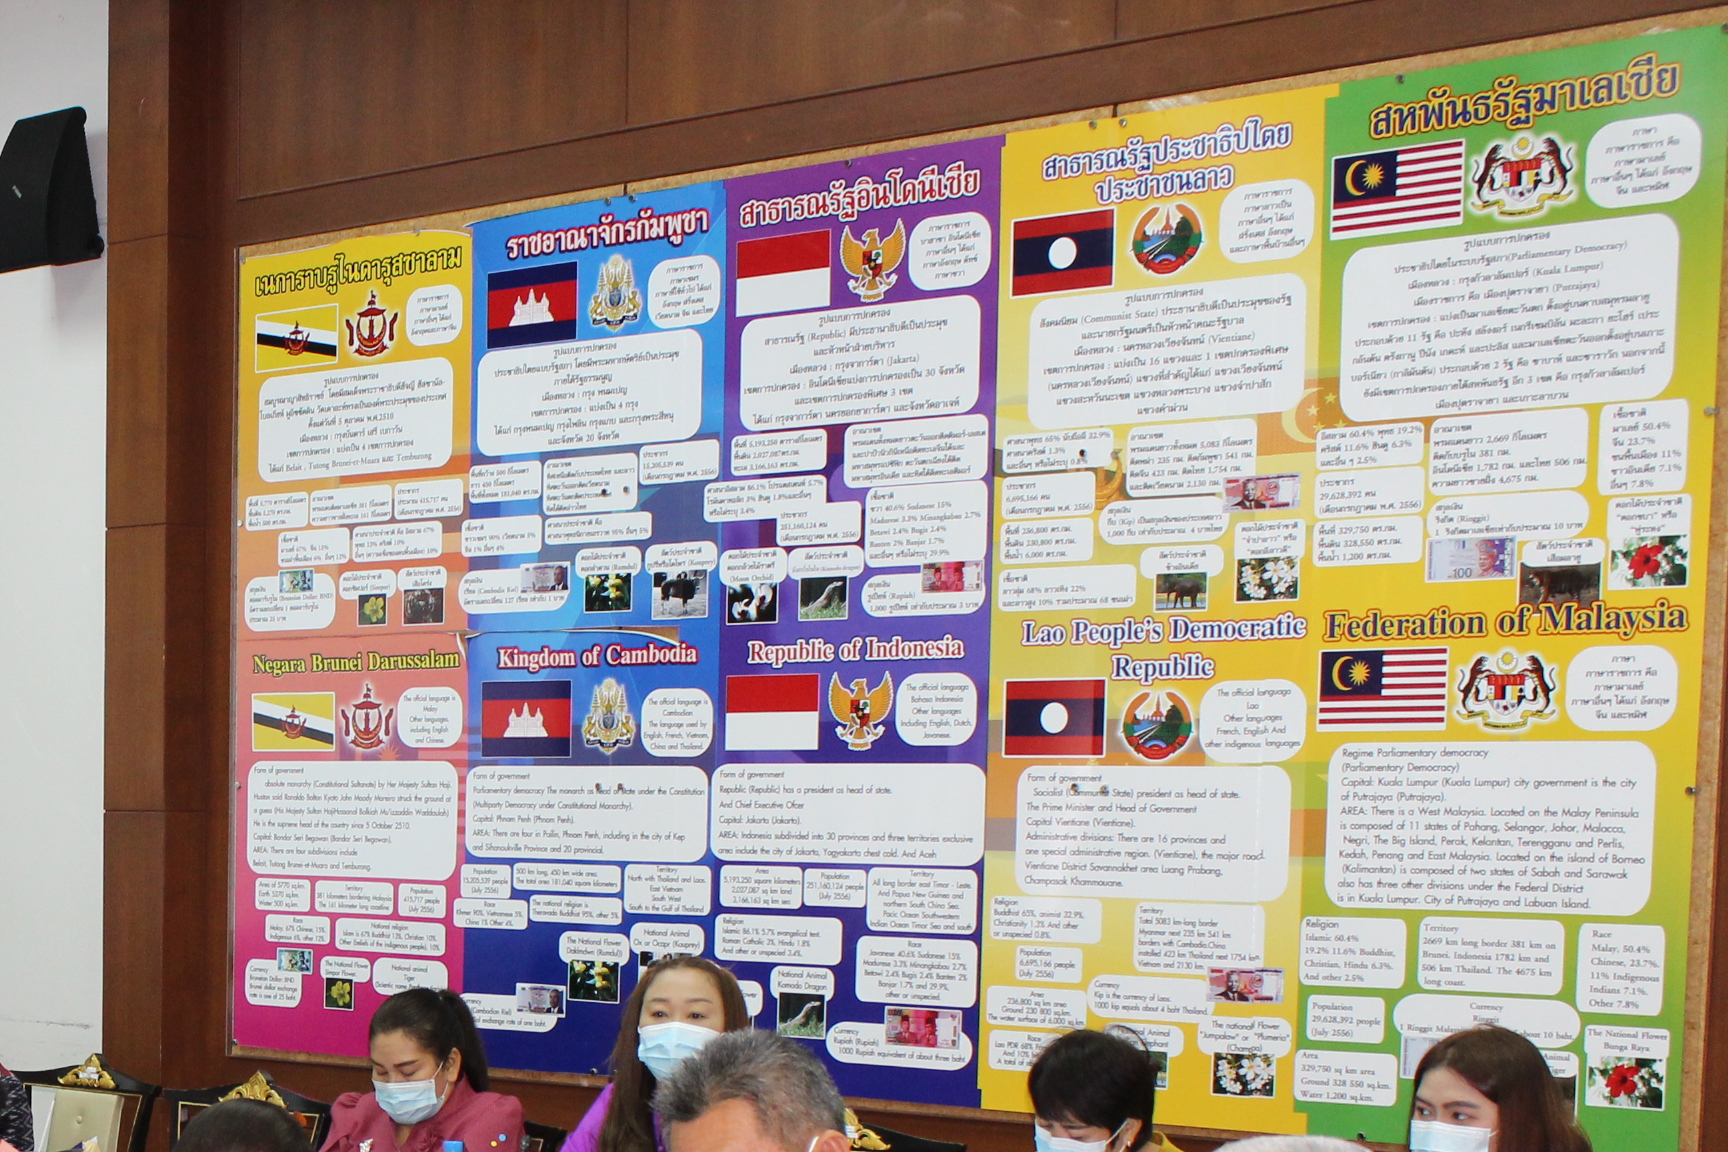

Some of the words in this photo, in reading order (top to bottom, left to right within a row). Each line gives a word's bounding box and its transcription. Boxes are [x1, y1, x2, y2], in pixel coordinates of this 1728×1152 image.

[1370, 52, 1682, 139] สหพันธรัฐมาเลเซีย
[1043, 116, 1293, 180] สาธารณรัฐประชาธิปไตย
[1095, 165, 1235, 205] ประชาชนลาว
[740, 161, 980, 227] สาธารณรัฐอินโดนีเซีย
[506, 207, 709, 260] ราชอาณาจักรกัมพูชา
[1324, 607, 1489, 642] Federation
[1497, 606, 1531, 636] of
[1539, 598, 1690, 640] Malaysia
[1021, 619, 1066, 646] Lao
[1072, 617, 1163, 650] People's
[1169, 612, 1307, 643] Democratic
[497, 646, 577, 673] Kingdom
[581, 644, 603, 667] of
[605, 640, 699, 666] Cambodia
[747, 638, 835, 668] Republic
[839, 637, 863, 662] of
[865, 634, 965, 661] Indonesia
[253, 654, 306, 677] Negara
[311, 652, 363, 672] Brunei
[368, 649, 461, 671] Darussalam
[1111, 653, 1215, 685] Republic
[1342, 748, 1374, 760] Regime
[1376, 746, 1437, 759] Parliamentary
[1439, 746, 1489, 759] democracy
[1341, 761, 1404, 774] (Parliamentary
[1406, 762, 1460, 774] Democracy)
[719, 770, 736, 778] Form
[737, 769, 745, 778] of
[746, 771, 785, 780] government
[1026, 773, 1046, 781] Form
[1047, 772, 1056, 781] of
[1058, 774, 1102, 786] government
[1377, 776, 1403, 786] Kuala
[1406, 777, 1438, 789] Lumpur
[1441, 776, 1471, 787] (Kuala
[1474, 777, 1510, 789] Lumpur)
[1513, 777, 1530, 789] city
[1532, 778, 1588, 789] government
[1590, 777, 1598, 787] is
[1601, 776, 1617, 787] the
[1619, 777, 1637, 789] city
[1340, 790, 1350, 801] of
[1352, 791, 1393, 803] Putrajaya
[1026, 801, 1039, 811] The
[1041, 802, 1063, 811] Prime
[1064, 802, 1095, 811] Minister
[1097, 802, 1113, 811] and
[1115, 802, 1136, 812] Head
[1138, 802, 1147, 812] of
[1148, 803, 1197, 813] Government
[1370, 805, 1395, 815] There
[1397, 807, 1405, 815] is
[1417, 806, 1441, 815] West
[1490, 806, 1525, 816] Located
[1543, 806, 1558, 817] the
[1560, 806, 1591, 819] Malay
[1594, 807, 1639, 818] Peninsula
[1025, 815, 1052, 828] Capital
[1054, 817, 1090, 826] Vientiane
[1305, 919, 1339, 930] Religion
[1423, 923, 1459, 934] Territory
[643, 928, 668, 936] National
[669, 929, 690, 937] Animal
[1305, 933, 1332, 941] Islamic
[1591, 929, 1612, 938] Race
[1422, 937, 1443, 945] 2669
[1444, 937, 1458, 945] km
[1460, 937, 1479, 949] long
[1480, 938, 1508, 947] border
[1509, 940, 1525, 948] 381
[1528, 940, 1542, 948] km
[777, 969, 804, 978] National
[805, 970, 827, 979] Animal
[1590, 971, 1610, 980] 11%
[1613, 972, 1660, 985] Indigenous
[777, 979, 802, 989] Komodo
[803, 981, 827, 992] Dragon
[1589, 984, 1620, 994] Indians
[1311, 1001, 1353, 1012] Population
[1588, 998, 1614, 1007] Other
[1356, 1017, 1382, 1028] people
[1587, 1028, 1602, 1038] The
[1604, 1029, 1638, 1039] National
[1641, 1032, 1669, 1042] Flower
[1603, 1042, 1628, 1052] Bunga
[1630, 1043, 1650, 1053] Raya
